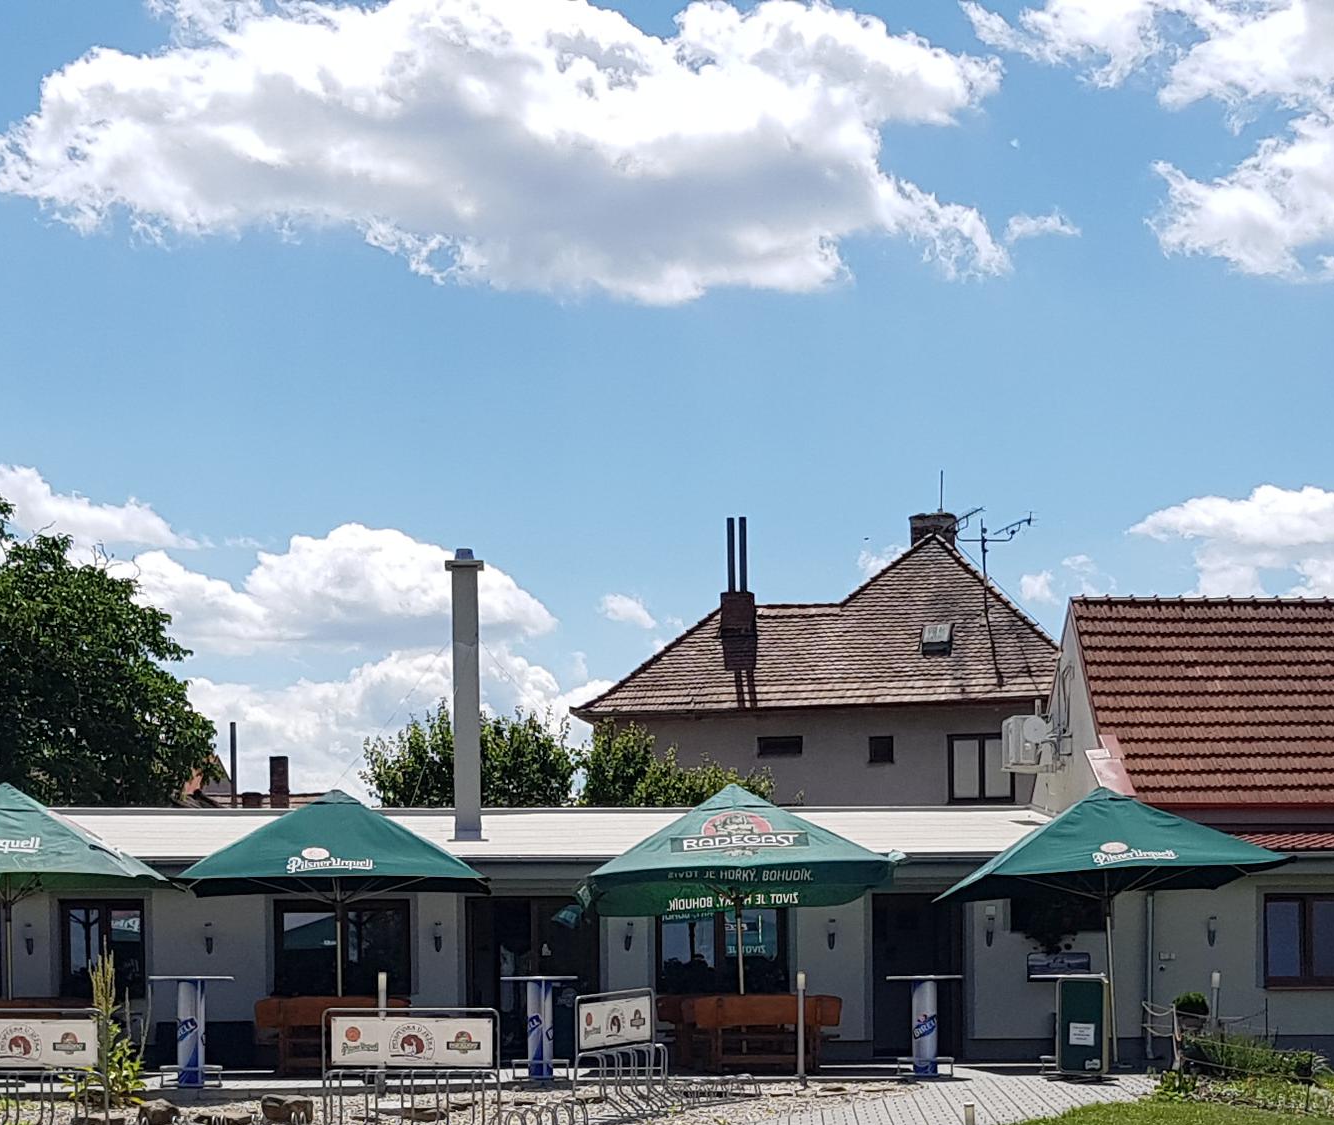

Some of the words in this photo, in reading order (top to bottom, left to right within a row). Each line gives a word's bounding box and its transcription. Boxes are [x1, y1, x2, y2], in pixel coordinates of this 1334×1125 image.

[683, 834, 799, 851] RADEGAST
[286, 856, 331, 874] Pilsner
[330, 856, 373, 870] Urquell
